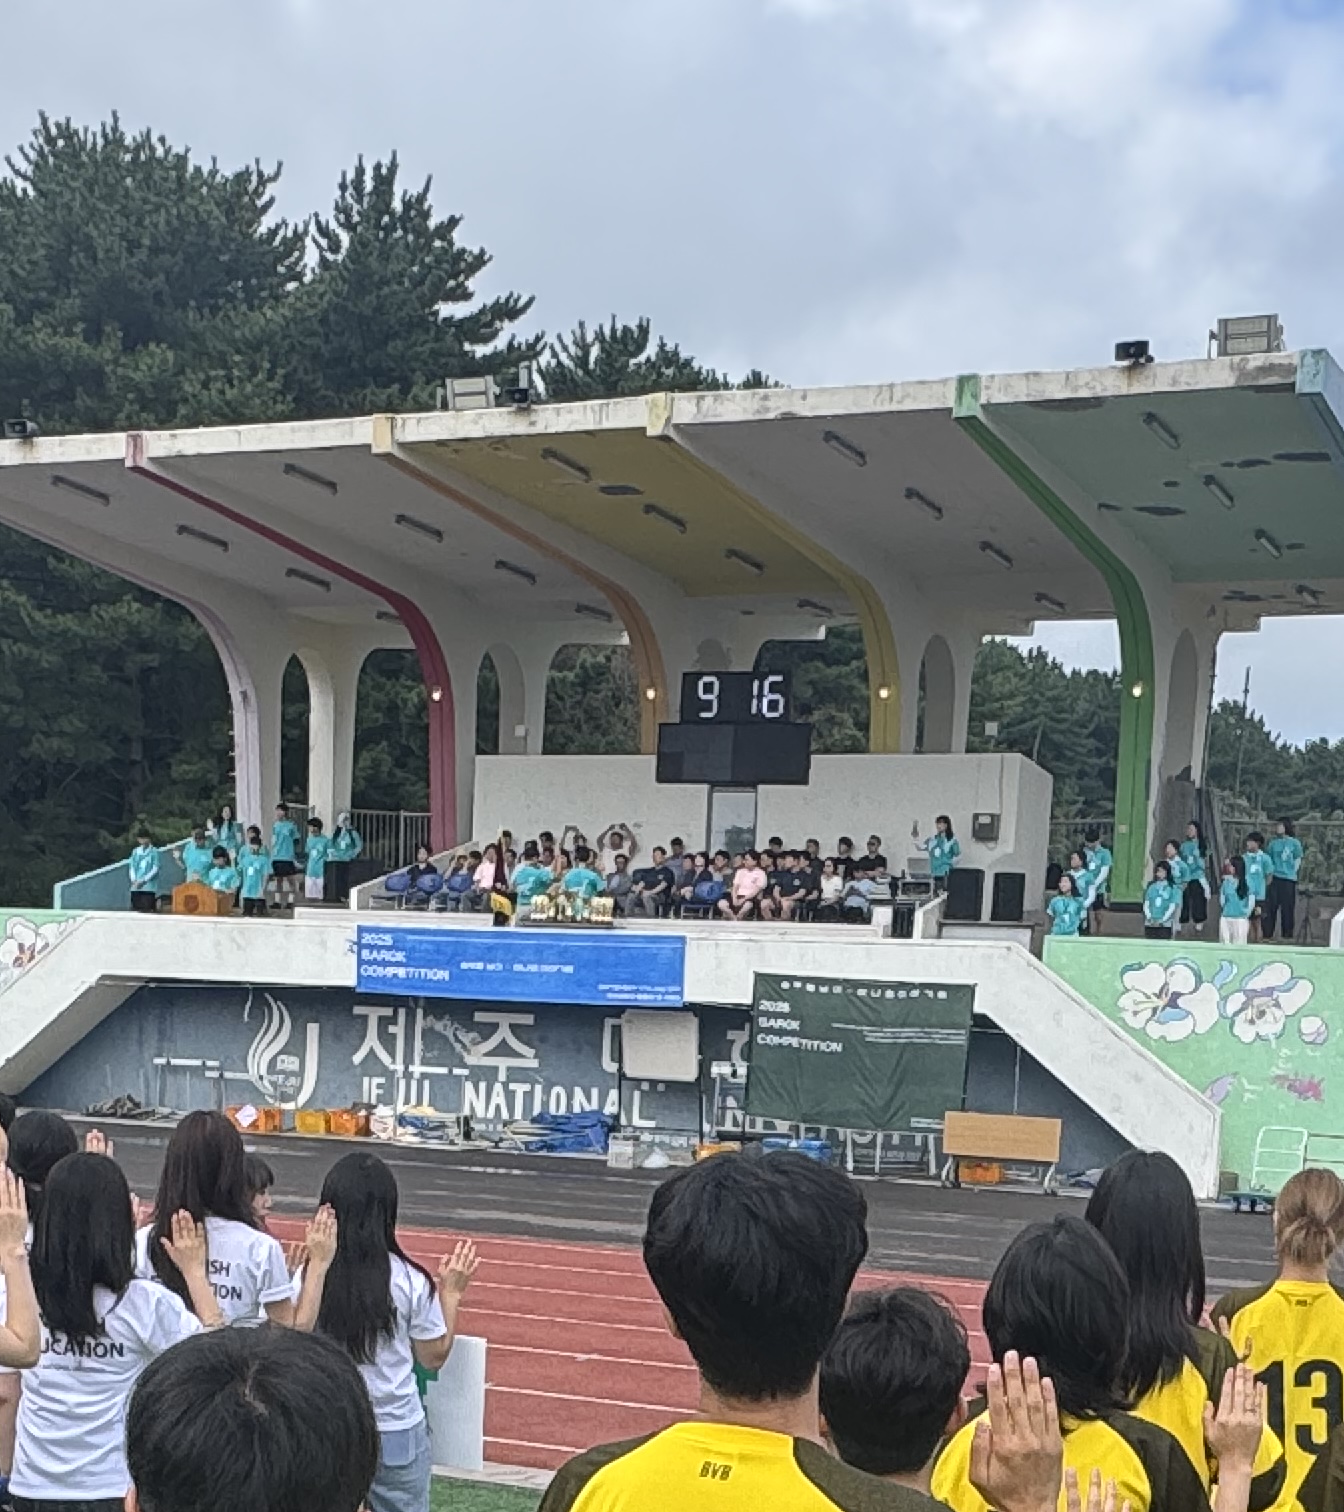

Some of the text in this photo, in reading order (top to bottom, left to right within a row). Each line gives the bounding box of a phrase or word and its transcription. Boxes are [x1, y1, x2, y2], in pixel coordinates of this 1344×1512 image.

[697, 675, 785, 718] 9 16
[360, 965, 450, 981] COMPETITION
[757, 1033, 843, 1052] COMPETITION
[463, 1080, 657, 1128] NATIONAL
[1253, 1359, 1344, 1454] 13
[699, 1460, 733, 1481] BVB
